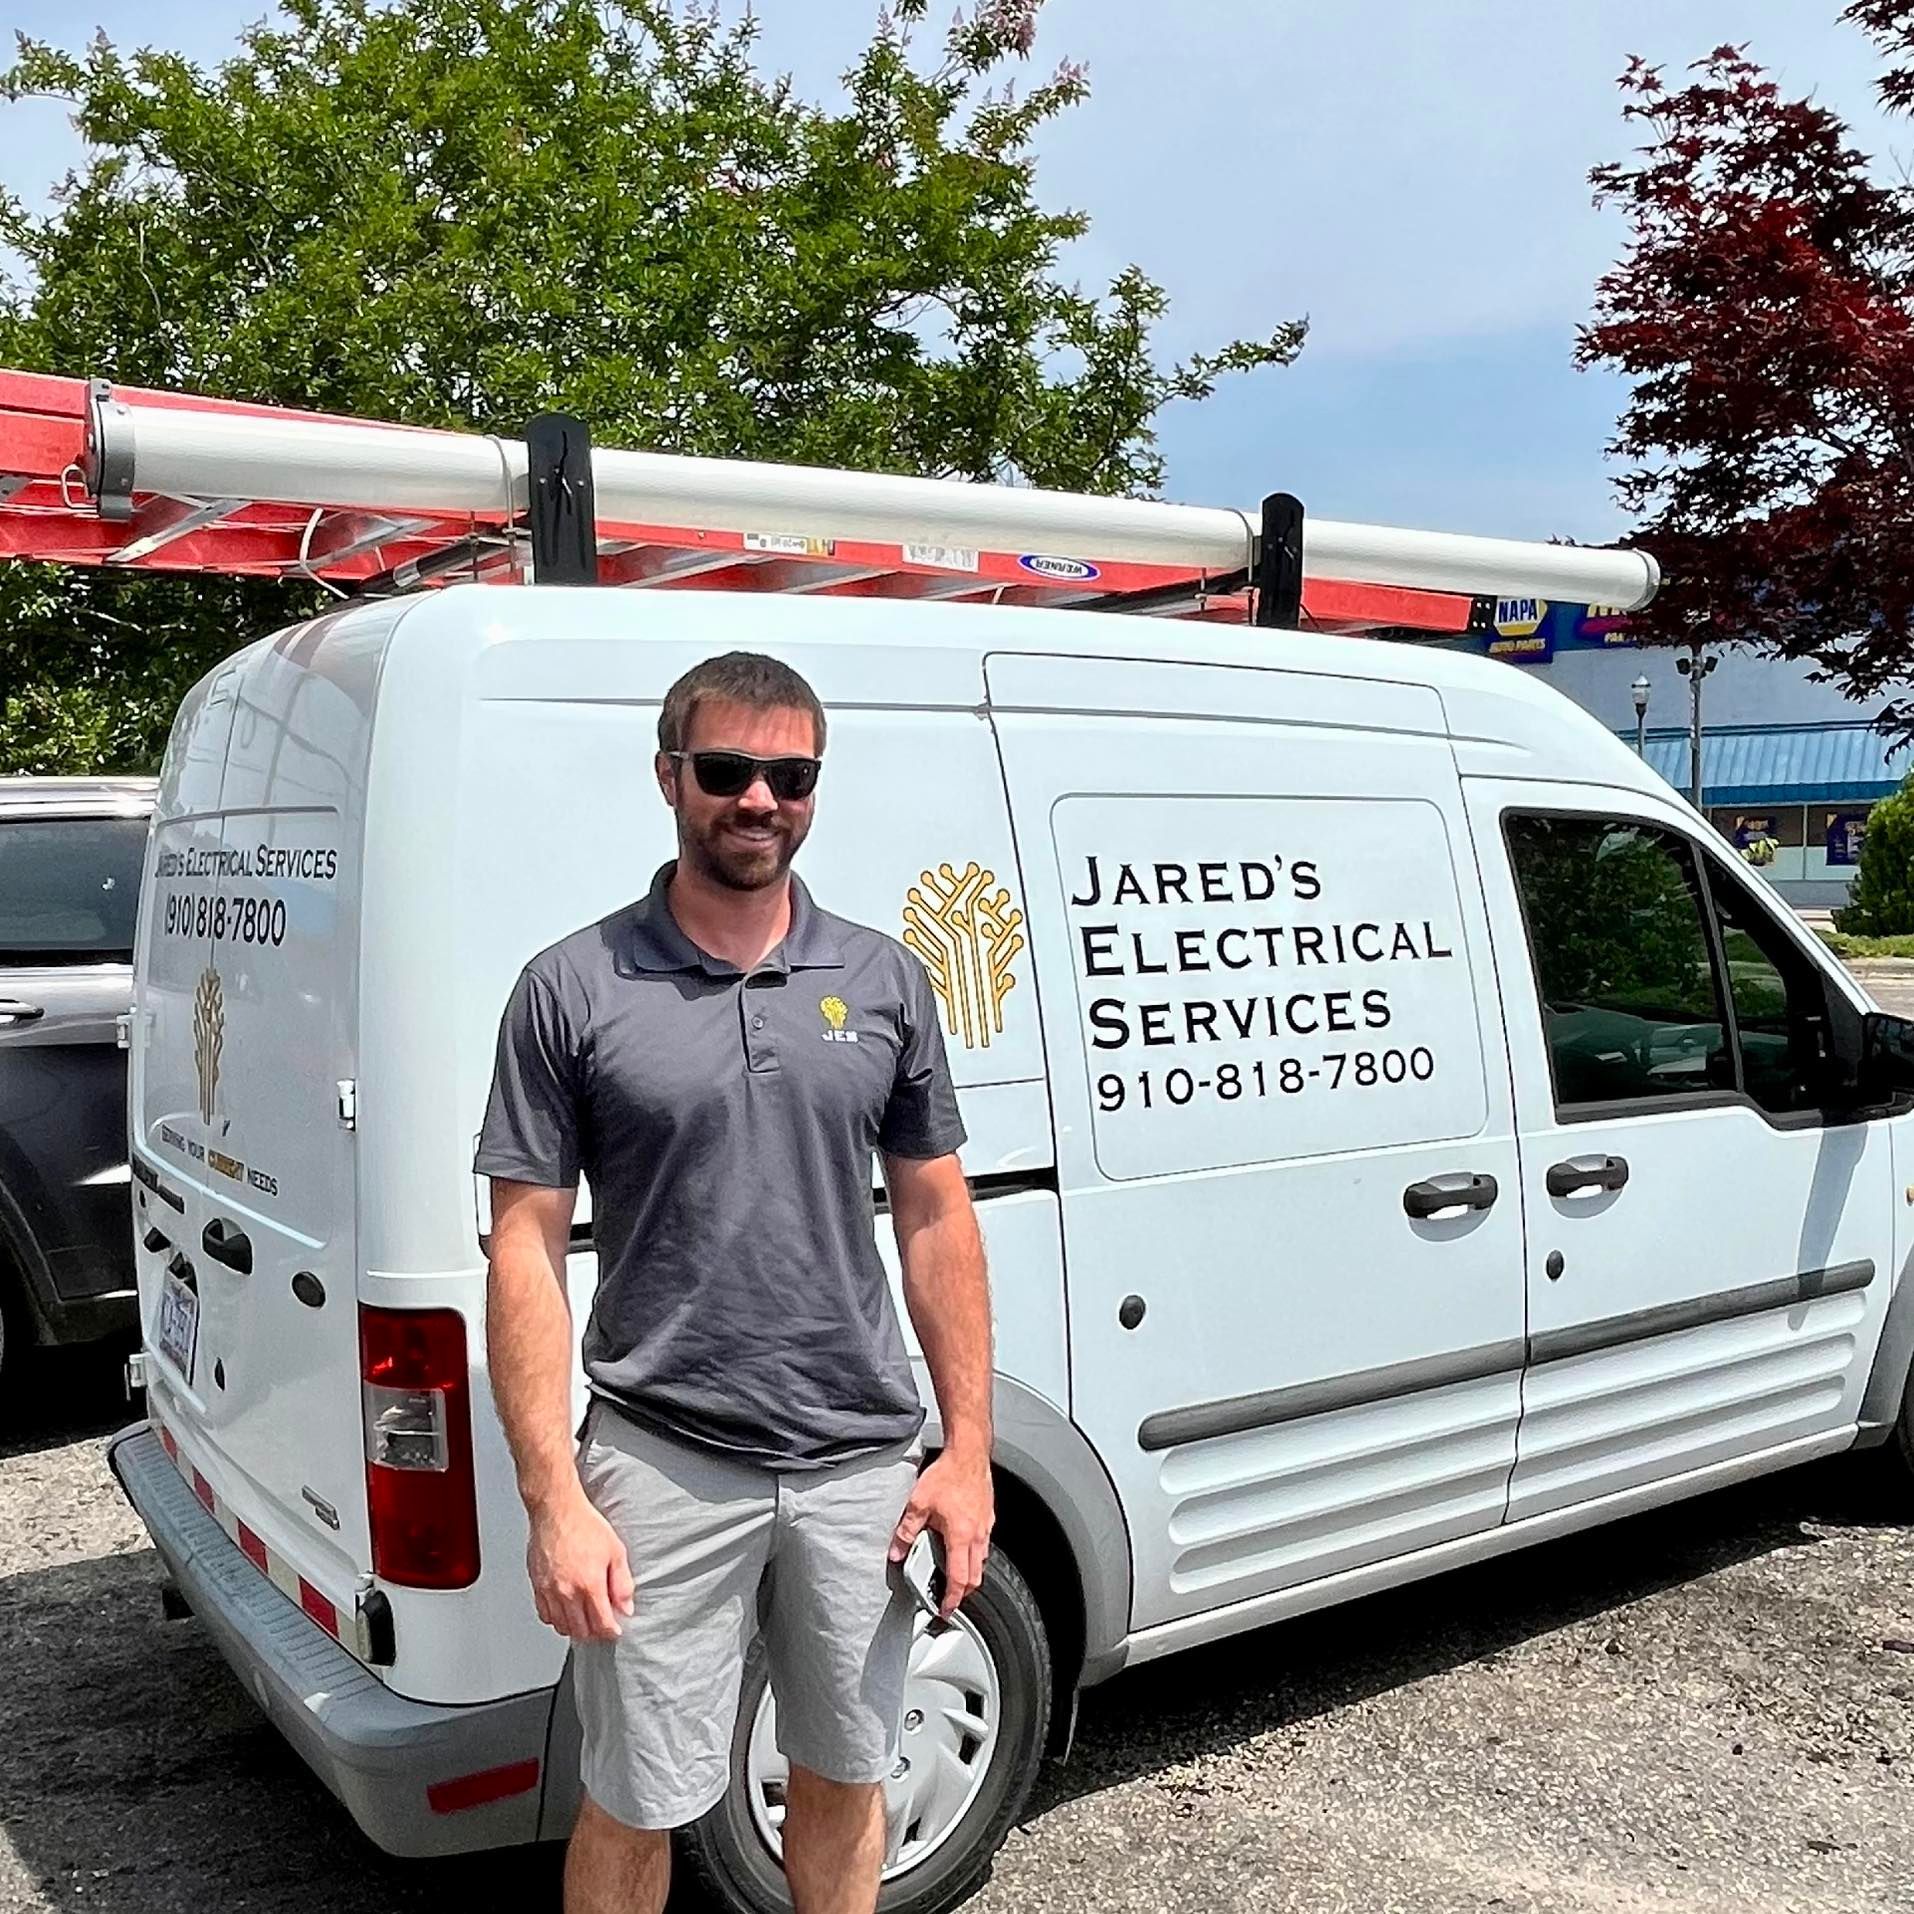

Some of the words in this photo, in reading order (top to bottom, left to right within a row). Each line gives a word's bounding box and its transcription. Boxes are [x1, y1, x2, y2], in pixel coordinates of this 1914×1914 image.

[1035, 560, 1083, 575] WERNER
[1499, 599, 1537, 623] NAPA
[186, 847, 252, 877] ELECTRICAL
[256, 844, 338, 879] SERVICES
[1072, 854, 1322, 907] JARED'S
[1080, 920, 1454, 978] ELECTRICAL
[1088, 989, 1392, 1050] SERVICES
[1098, 1046, 1435, 1112] 910-818-7800
[247, 1167, 278, 1197] NEEDS
